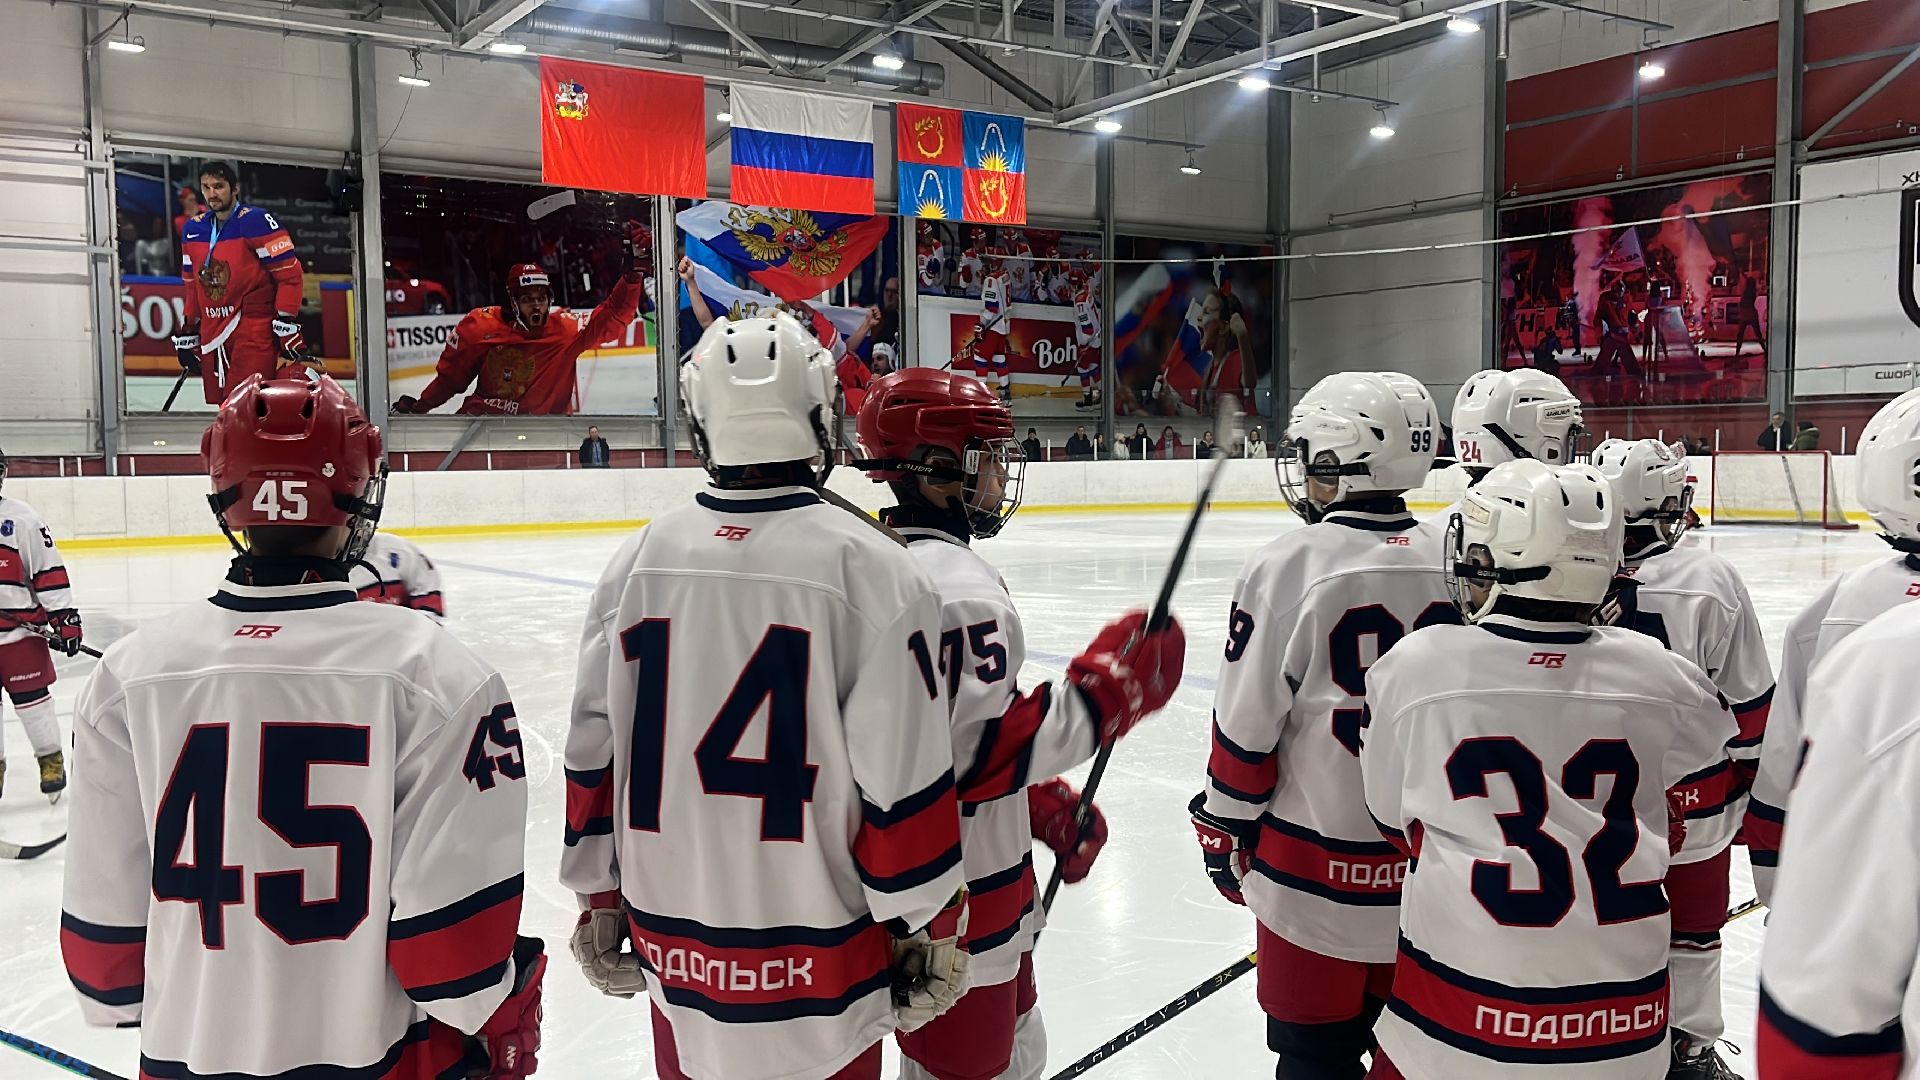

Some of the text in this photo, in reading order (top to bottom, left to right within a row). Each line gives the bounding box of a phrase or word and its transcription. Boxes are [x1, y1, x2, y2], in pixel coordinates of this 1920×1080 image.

[265, 213, 279, 230] 8
[1410, 430, 1431, 453] 99
[1459, 440, 1482, 463] 24
[40, 525, 56, 549] 5
[252, 479, 308, 522] 45
[942, 618, 1007, 700] 75
[1328, 602, 1465, 758] 9
[462, 702, 527, 792] 45
[619, 617, 820, 843] 14
[152, 722, 373, 950] 45
[1444, 736, 1671, 928] 32
[1074, 969, 1233, 1073] CATALYST 3X
